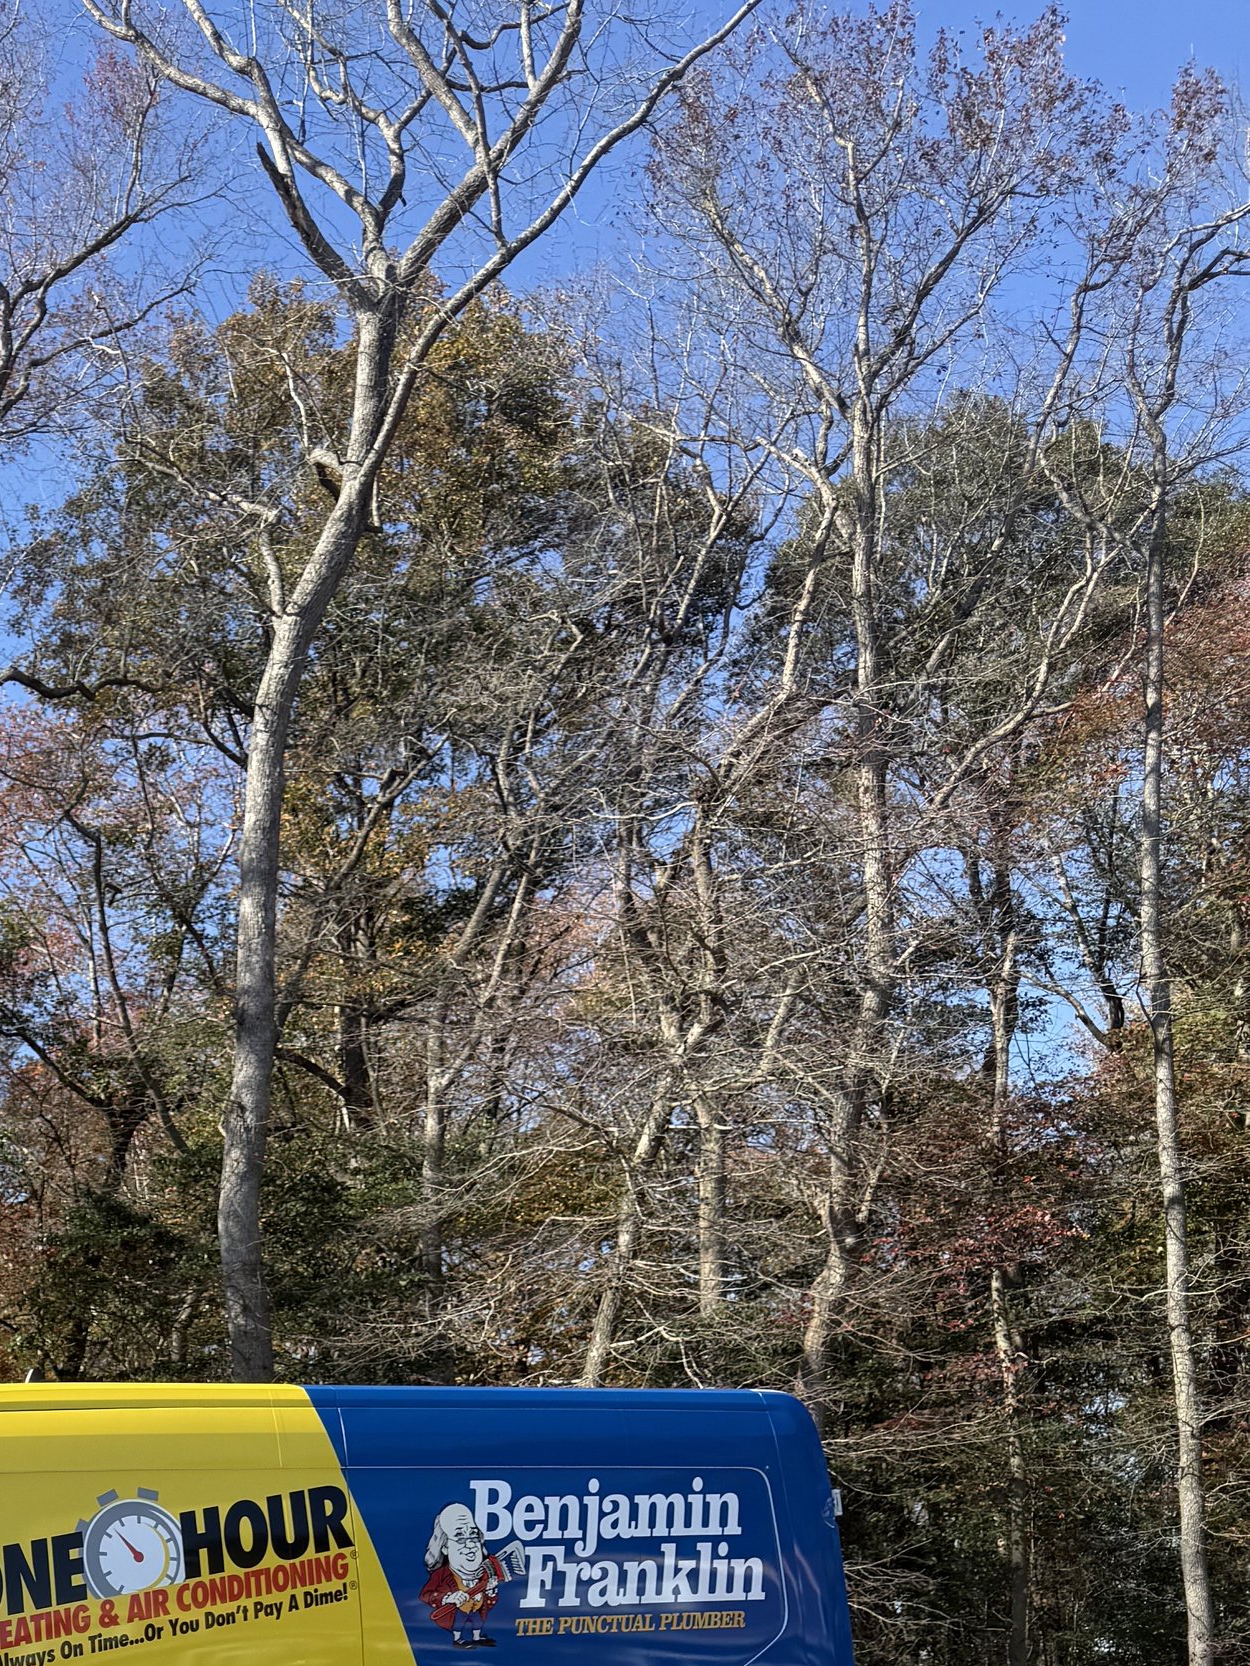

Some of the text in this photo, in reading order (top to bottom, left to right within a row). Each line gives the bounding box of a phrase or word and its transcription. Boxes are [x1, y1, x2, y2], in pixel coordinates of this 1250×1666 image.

[180, 1485, 355, 1580] HOUR
[469, 1476, 742, 1557] Benjamin
[100, 1599, 121, 1628] &
[126, 1589, 171, 1623] AIR
[176, 1552, 350, 1612] CONDITIONING
[519, 1541, 766, 1608] Franklin
[60, 1640, 84, 1659] On
[168, 1617, 200, 1636] You
[204, 1604, 249, 1629] Don't
[253, 1600, 283, 1620] Pay
[288, 1593, 299, 1612] A
[303, 1582, 349, 1609] Dime!
[515, 1611, 746, 1637] THE PUNCTUAL PLUMBER
